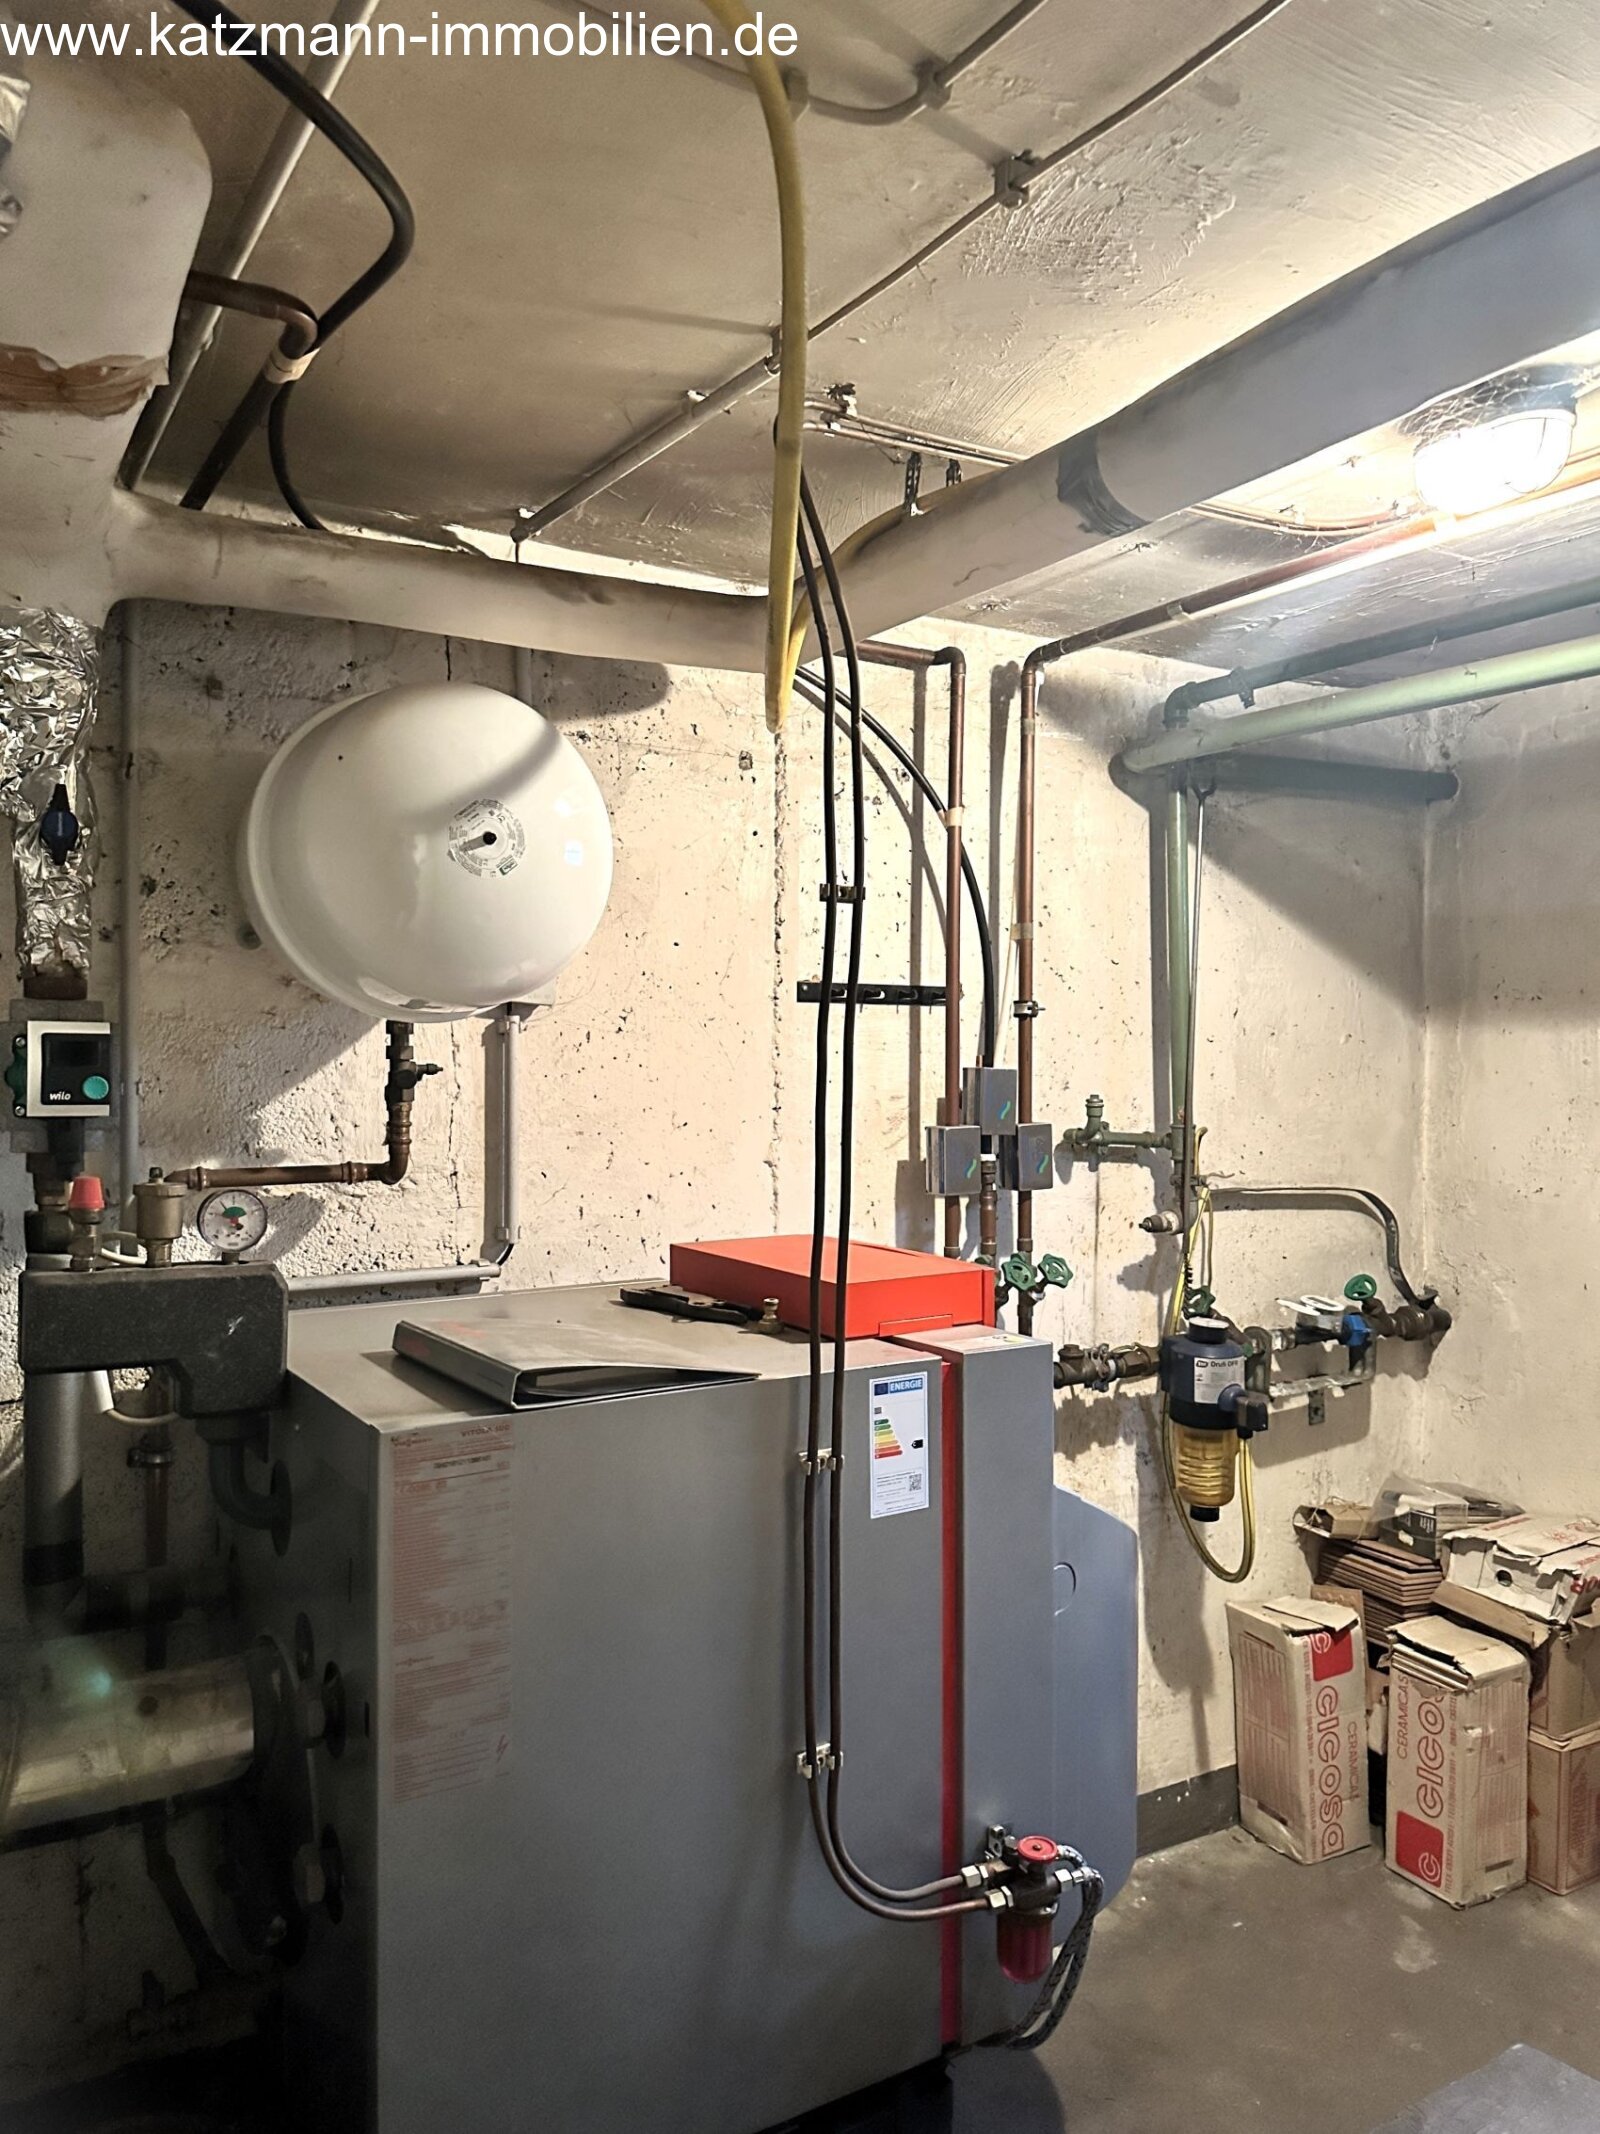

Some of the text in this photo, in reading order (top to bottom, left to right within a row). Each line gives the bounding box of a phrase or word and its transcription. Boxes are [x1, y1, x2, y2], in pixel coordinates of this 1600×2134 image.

[50, 1091, 71, 1101] wilo
[890, 1378, 922, 1392] ENERGIE
[1397, 1675, 1410, 1759] CERAMICAS
